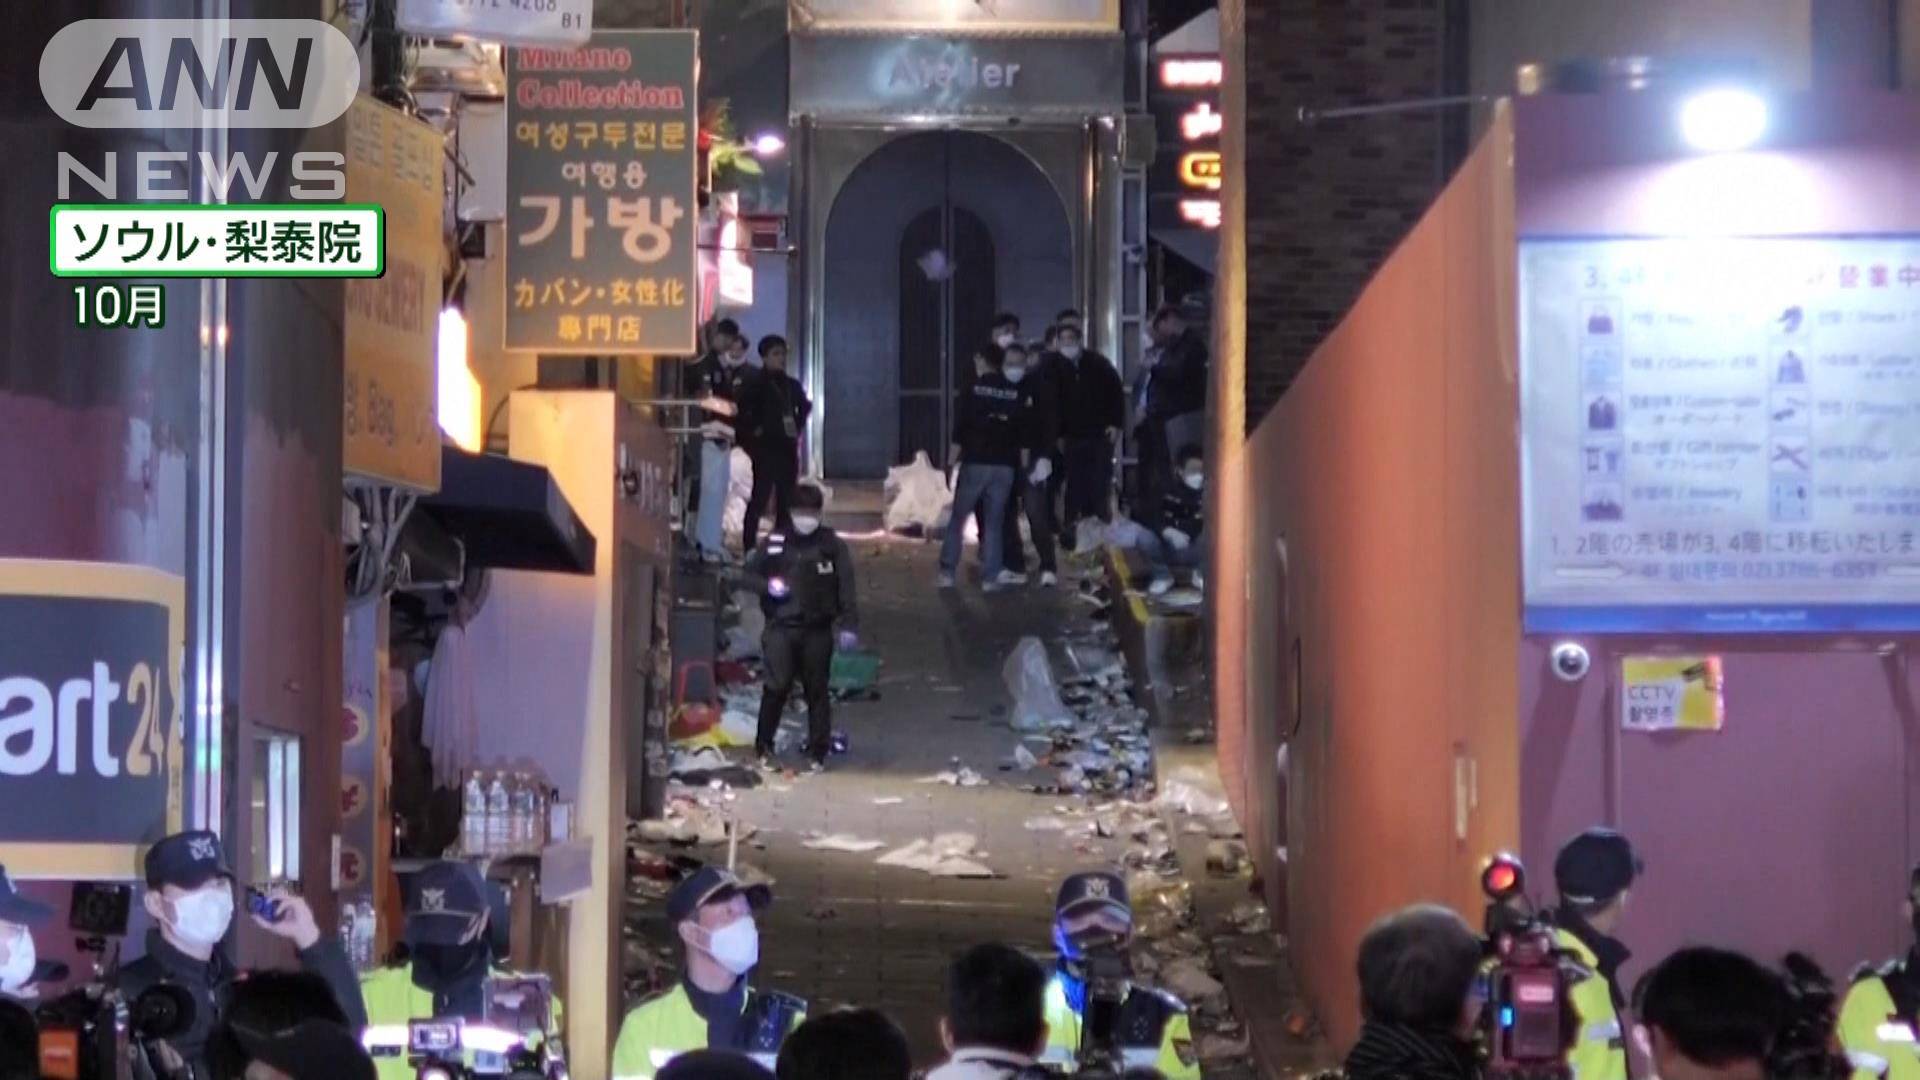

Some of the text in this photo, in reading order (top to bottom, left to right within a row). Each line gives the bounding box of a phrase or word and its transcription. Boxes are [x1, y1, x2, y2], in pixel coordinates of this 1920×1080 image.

[561, 13, 583, 30] B1
[517, 78, 685, 110] Collection
[561, 160, 648, 190] 여행용
[518, 196, 684, 263] 가방
[514, 277, 685, 308] カバン・女性化
[1628, 685, 1676, 701] CCTV
